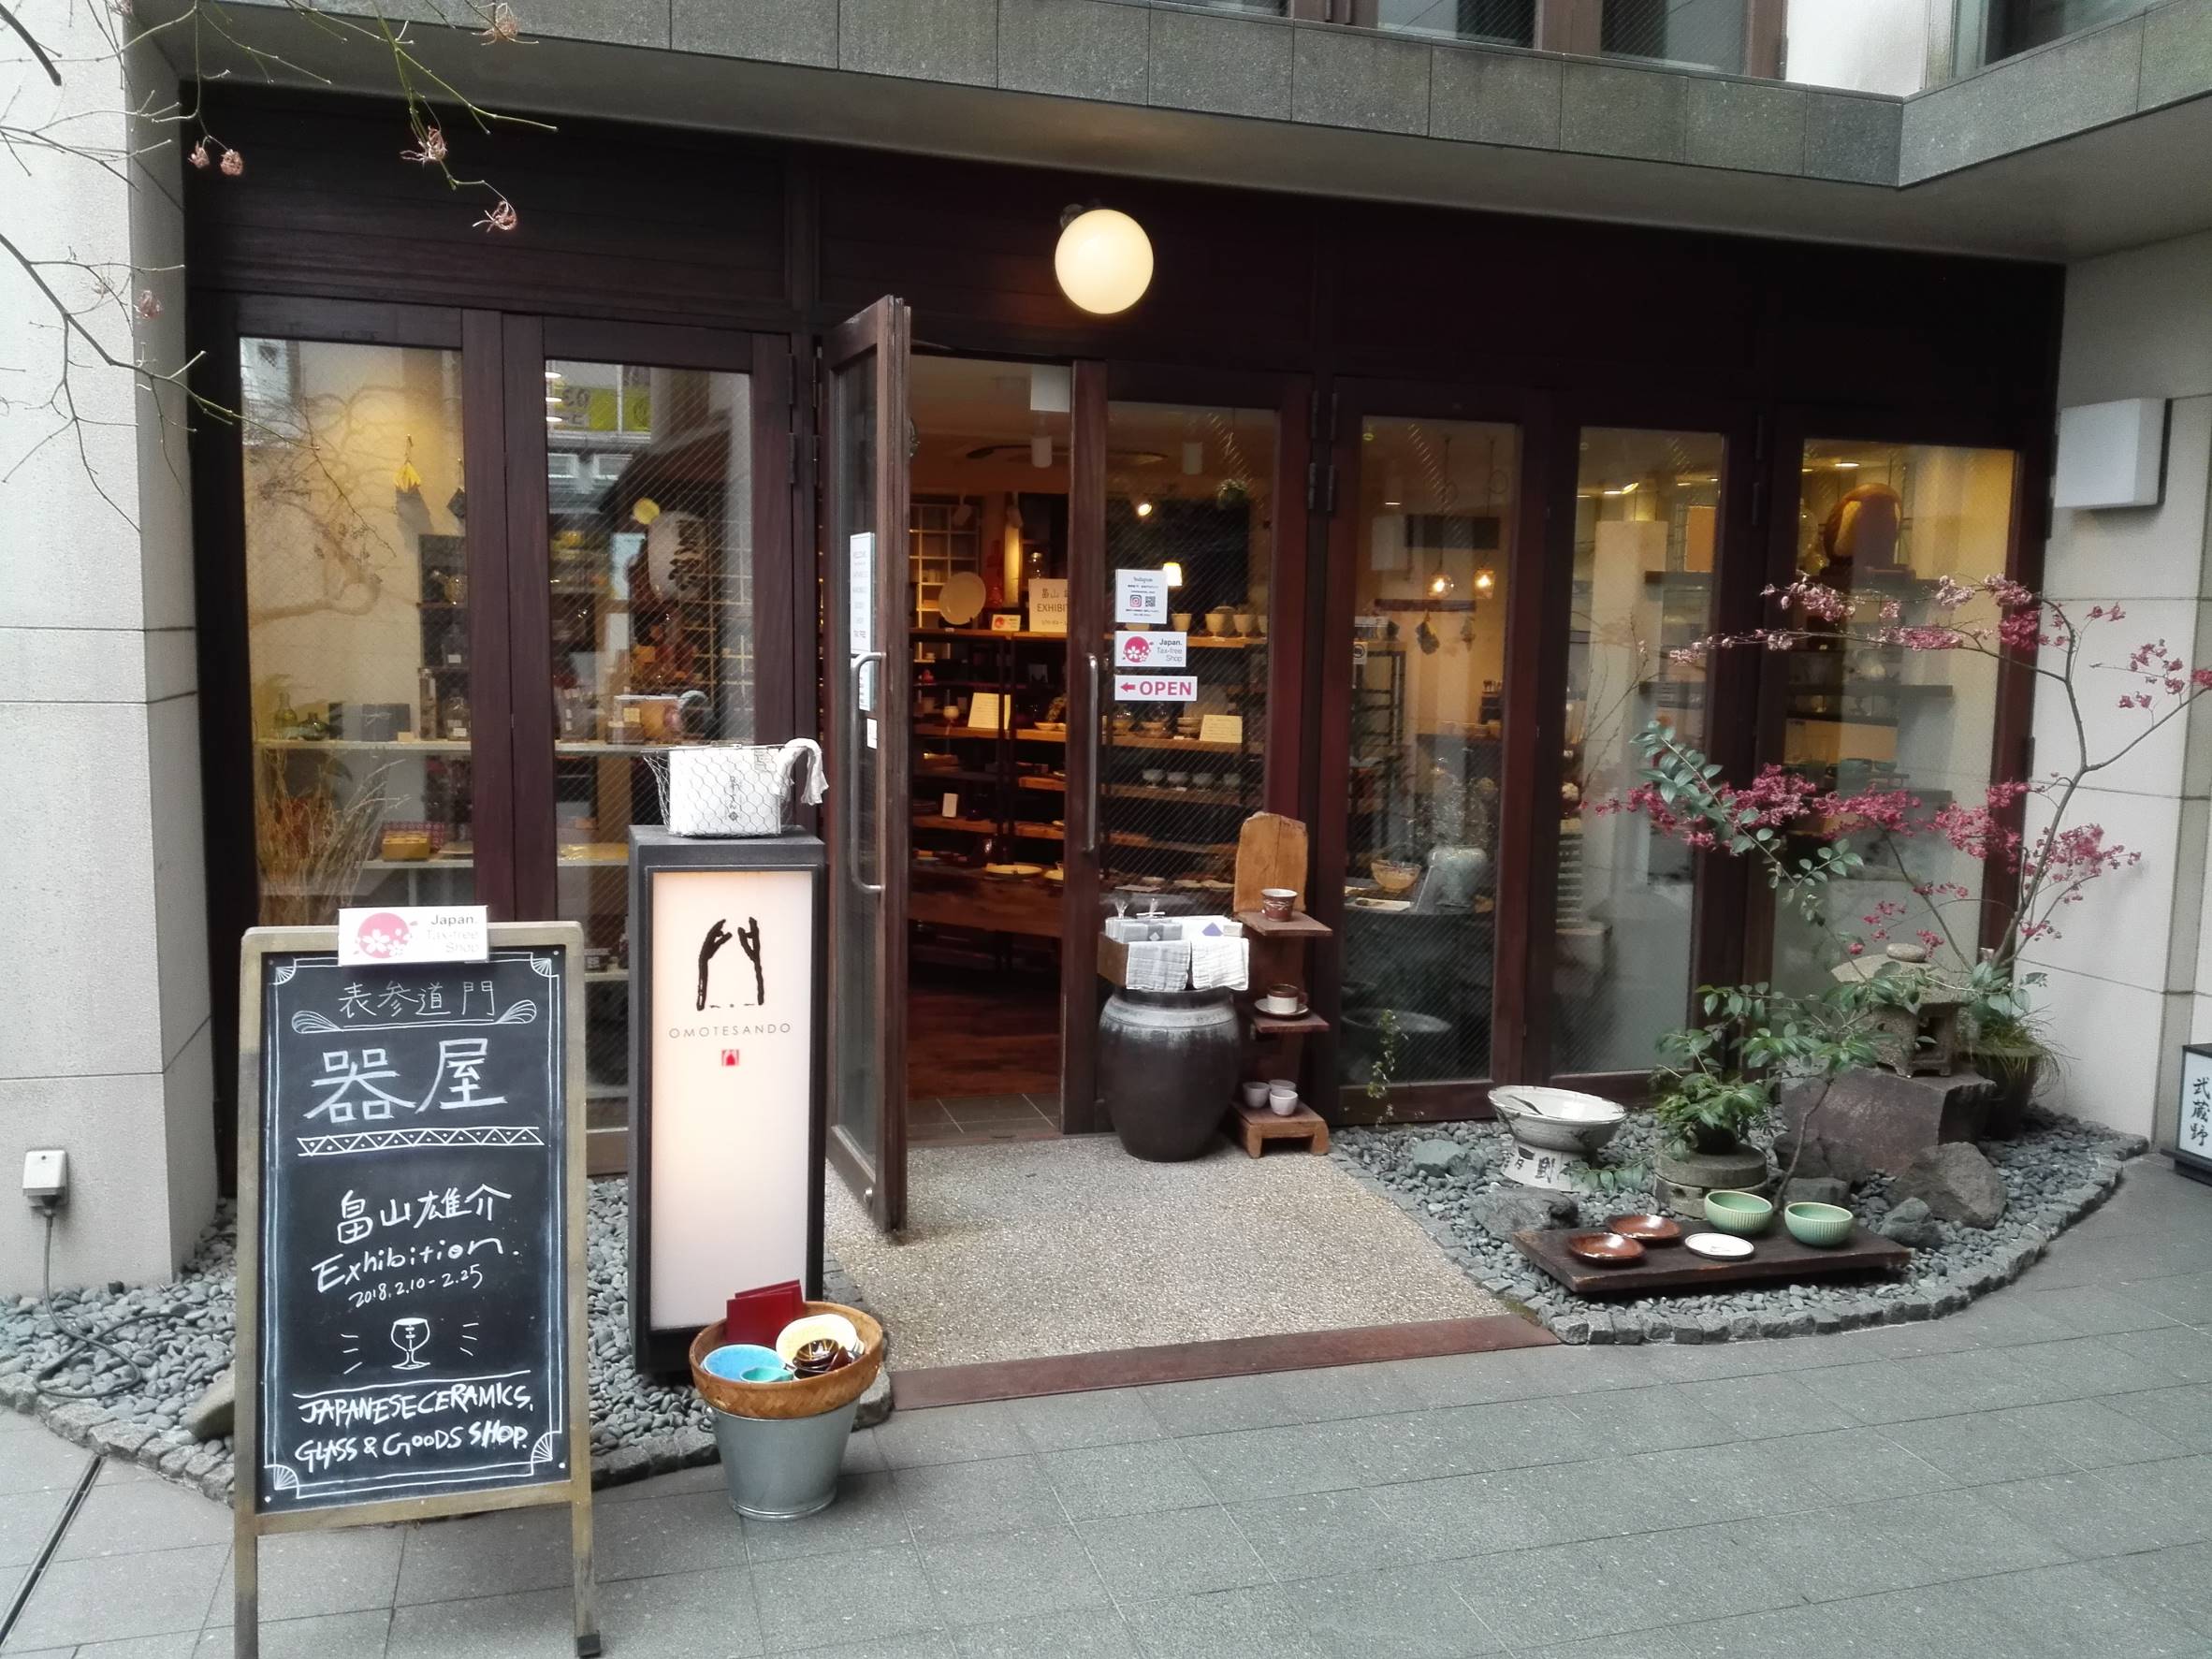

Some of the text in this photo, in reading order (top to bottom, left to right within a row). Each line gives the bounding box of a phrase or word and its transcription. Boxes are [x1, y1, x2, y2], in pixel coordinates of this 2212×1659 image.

[1140, 681, 1192, 696] OPEN
[338, 981, 495, 1019] 表参道門
[668, 1023, 791, 1038] OMOTESANDO
[303, 1038, 507, 1123] 器屋
[2190, 1077, 2210, 1146] 武蔵野
[295, 1439, 357, 1473] GLASS
[364, 1437, 378, 1458] &
